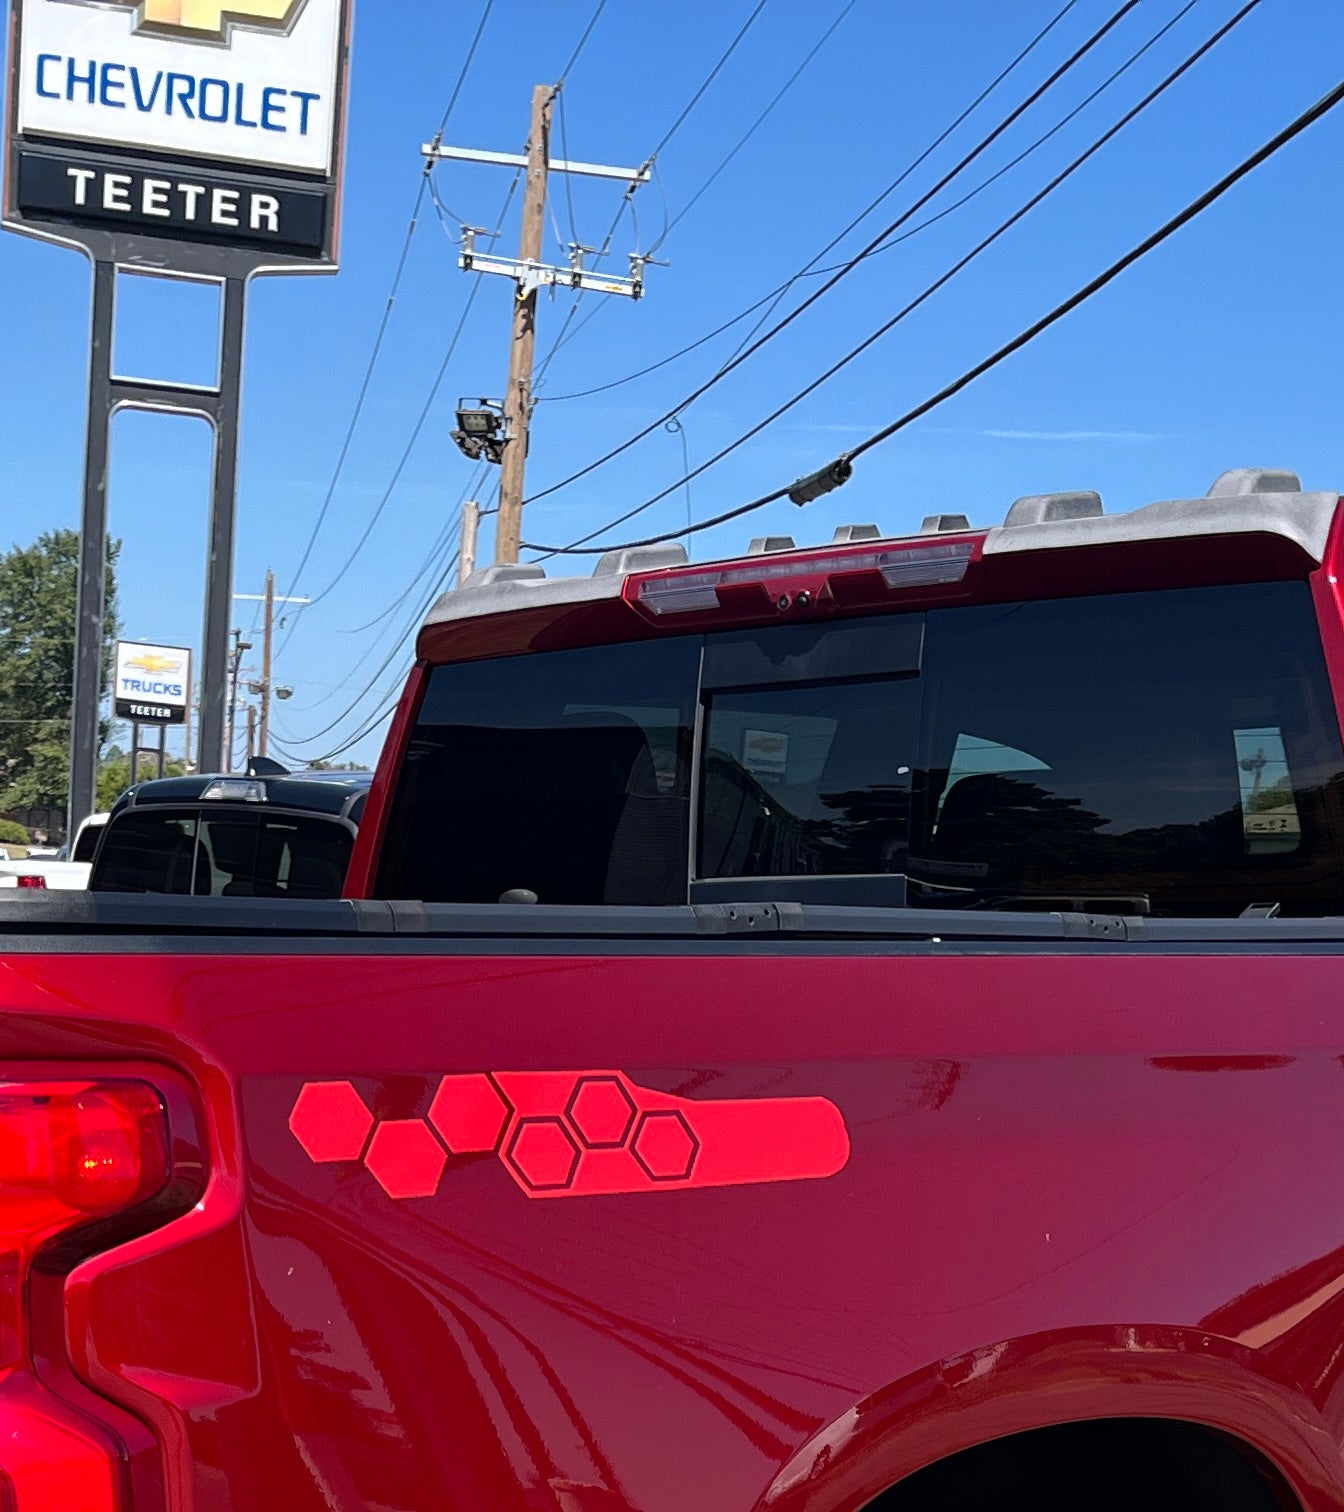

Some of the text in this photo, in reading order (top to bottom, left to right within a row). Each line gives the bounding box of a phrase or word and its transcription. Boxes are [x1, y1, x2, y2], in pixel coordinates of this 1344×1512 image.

[36, 53, 321, 136] CHEVROLET
[66, 167, 281, 233] TEETER
[121, 678, 182, 696] TRUCKS
[129, 704, 172, 718] TEETER
